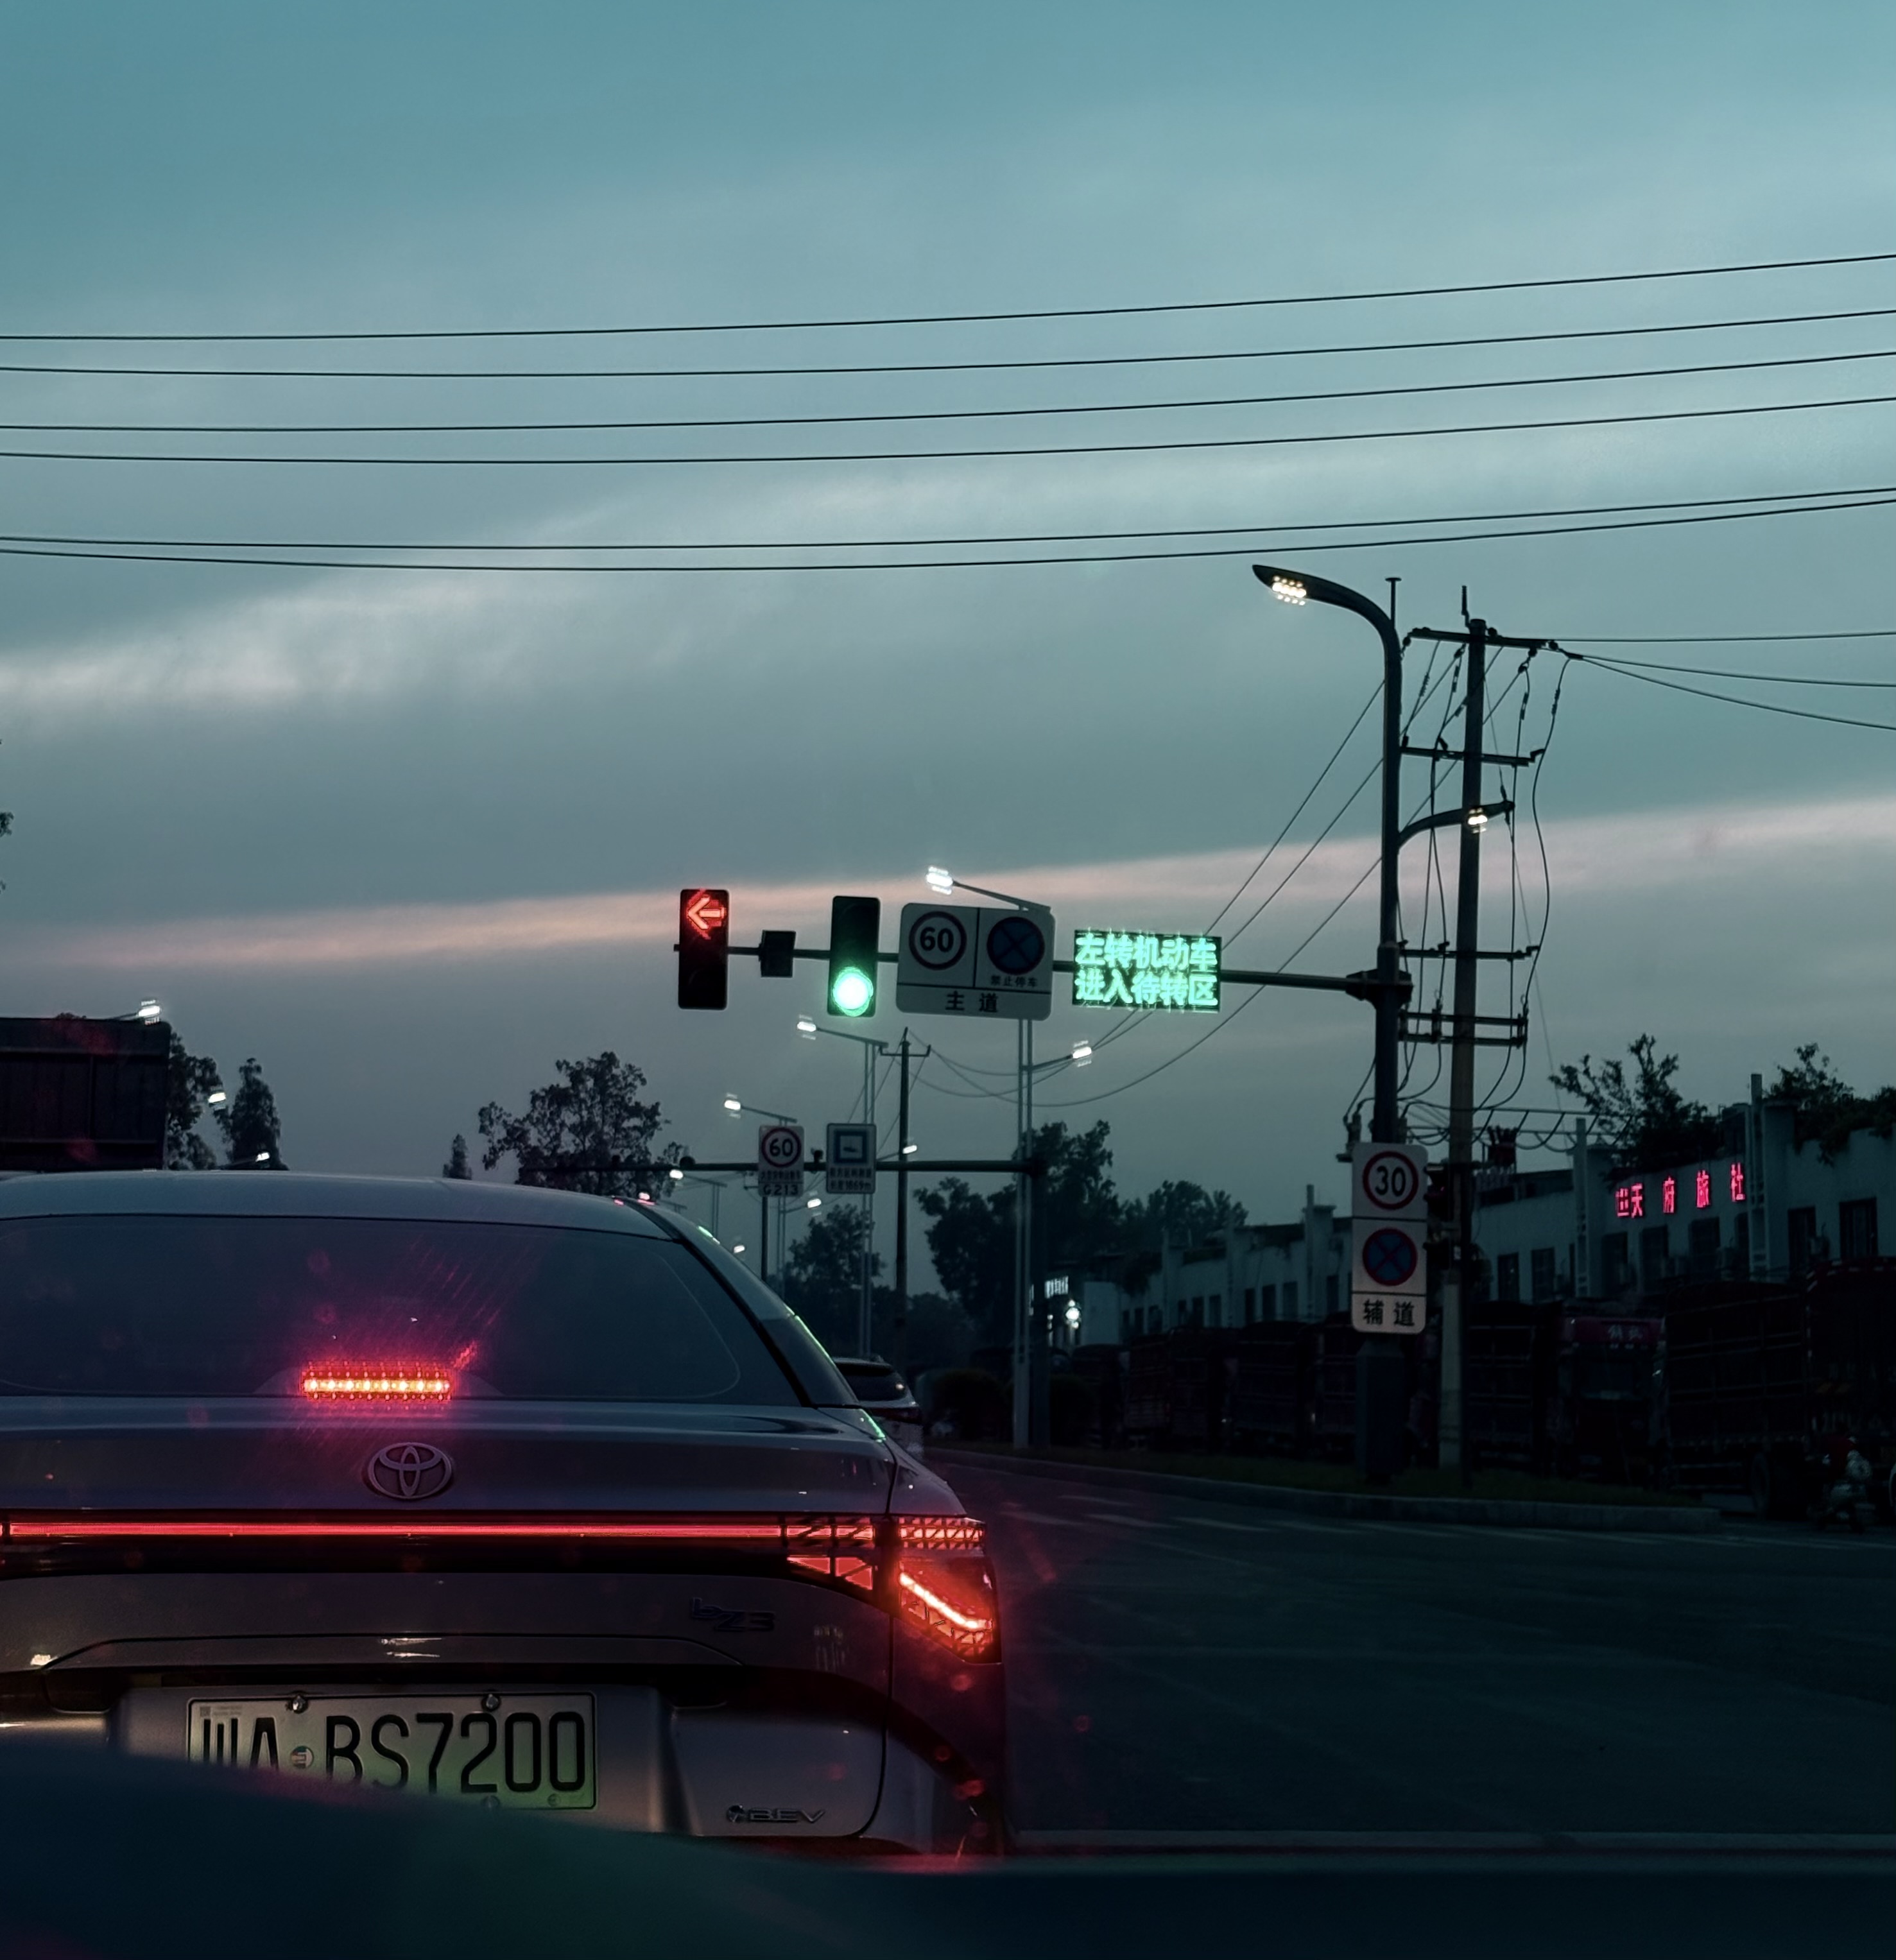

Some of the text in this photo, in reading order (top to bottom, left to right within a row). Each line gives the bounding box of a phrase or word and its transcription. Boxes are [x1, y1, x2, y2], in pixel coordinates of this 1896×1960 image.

[920, 927, 953, 952] 60
[945, 991, 997, 1012] 主道
[770, 1139, 793, 1156] 60
[1376, 1166, 1405, 1196] 30
[1363, 1300, 1414, 1326] 辅道
